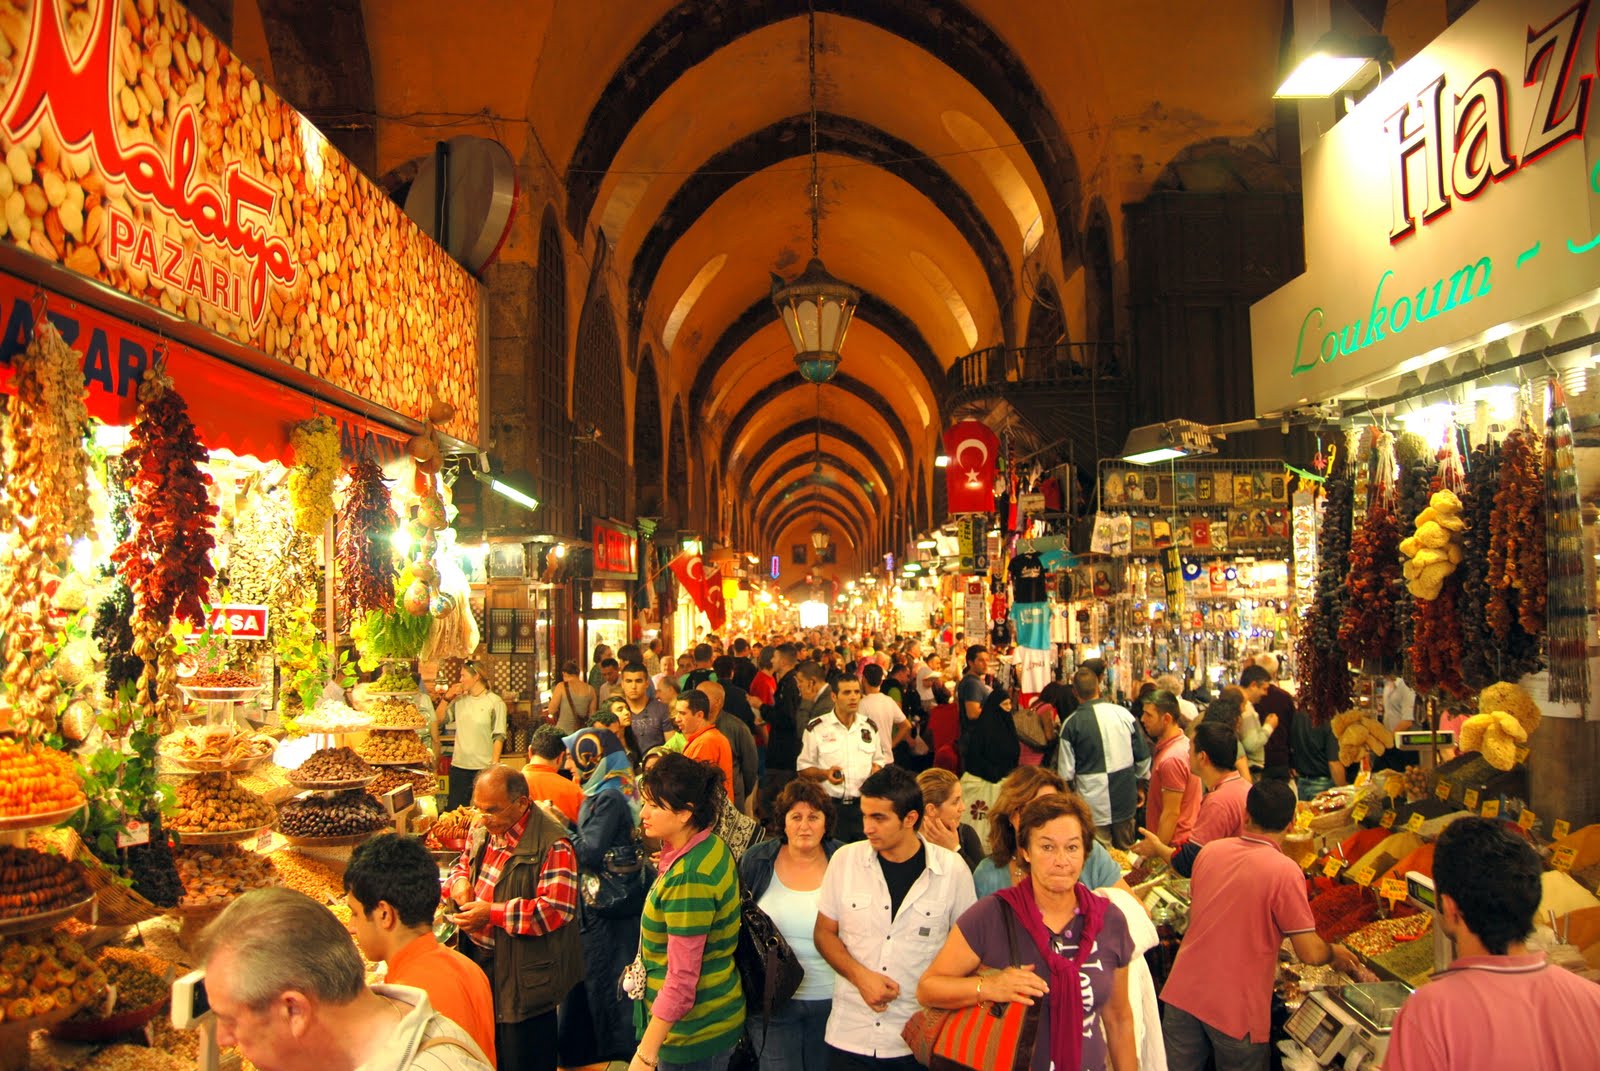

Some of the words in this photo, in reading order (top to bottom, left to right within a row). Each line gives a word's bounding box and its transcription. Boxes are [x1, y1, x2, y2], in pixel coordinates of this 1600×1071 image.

[1384, 0, 1600, 245] Haz
[1291, 258, 1493, 378] Loukoum
[194, 612, 260, 632] ASA
